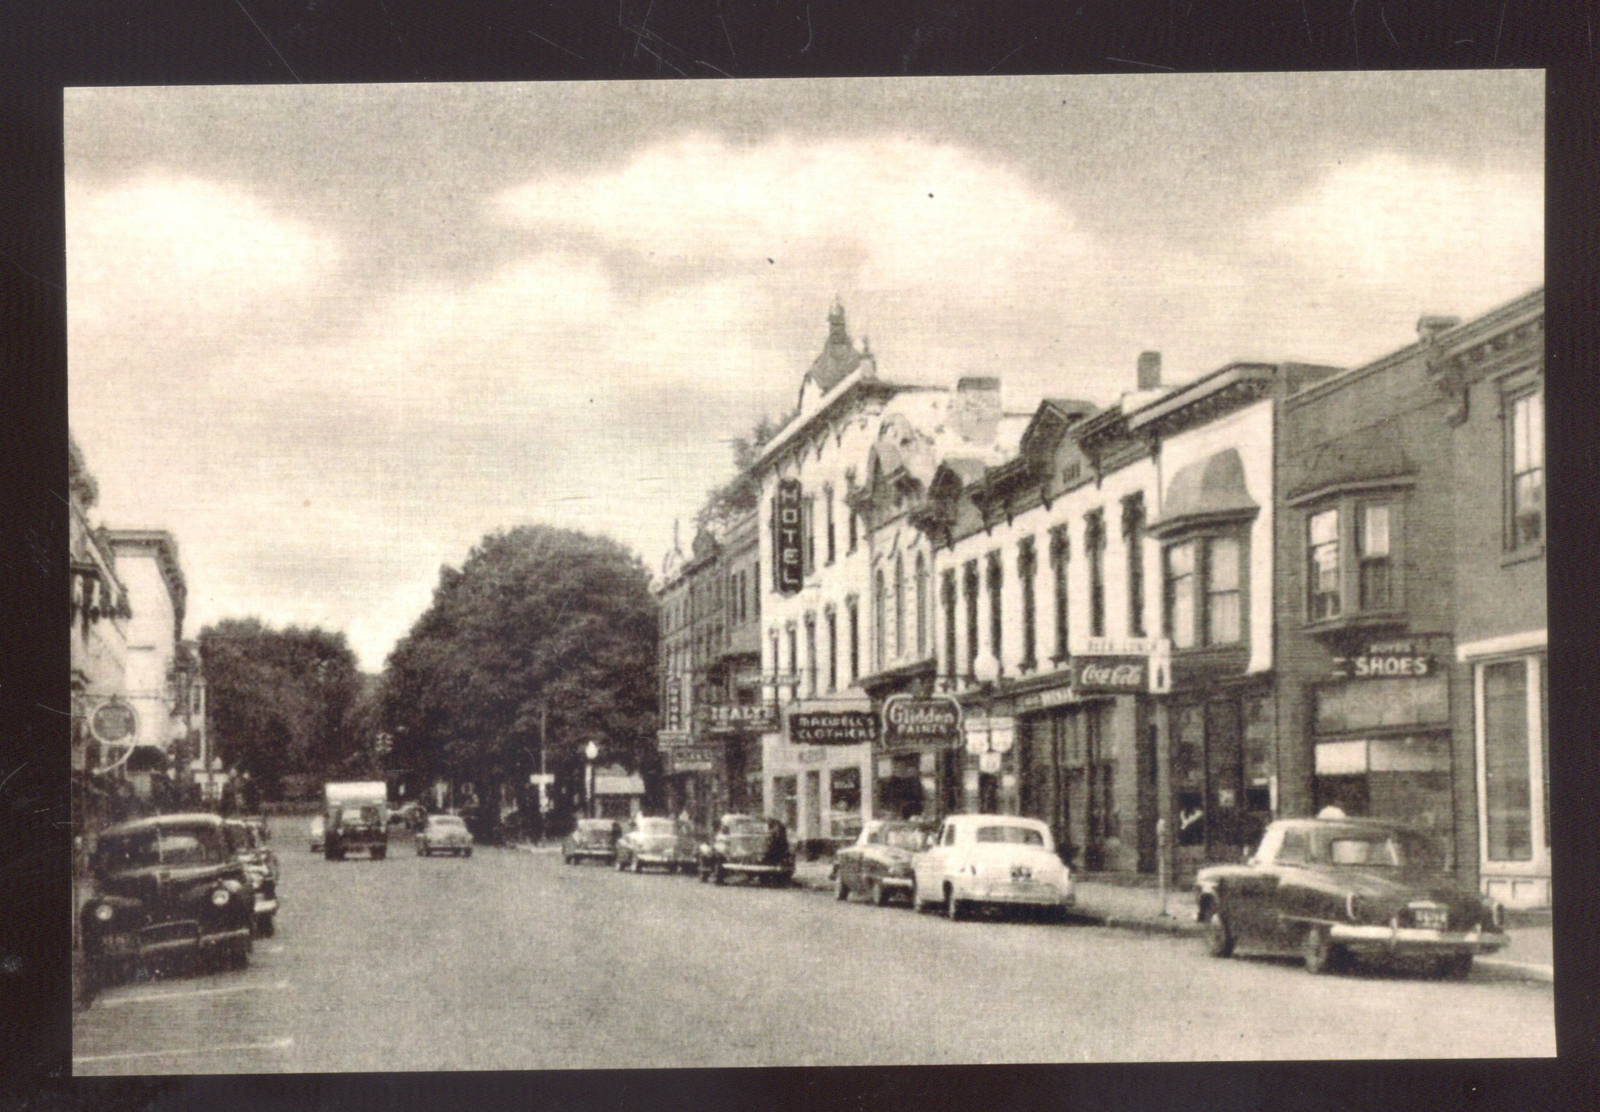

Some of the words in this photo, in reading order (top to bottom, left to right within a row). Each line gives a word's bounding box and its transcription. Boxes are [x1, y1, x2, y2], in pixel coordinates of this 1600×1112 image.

[782, 488, 799, 584] HOTEL
[1354, 656, 1428, 676] SHOES
[889, 703, 955, 724] Glidden
[798, 728, 876, 740] CLOTHIERS
